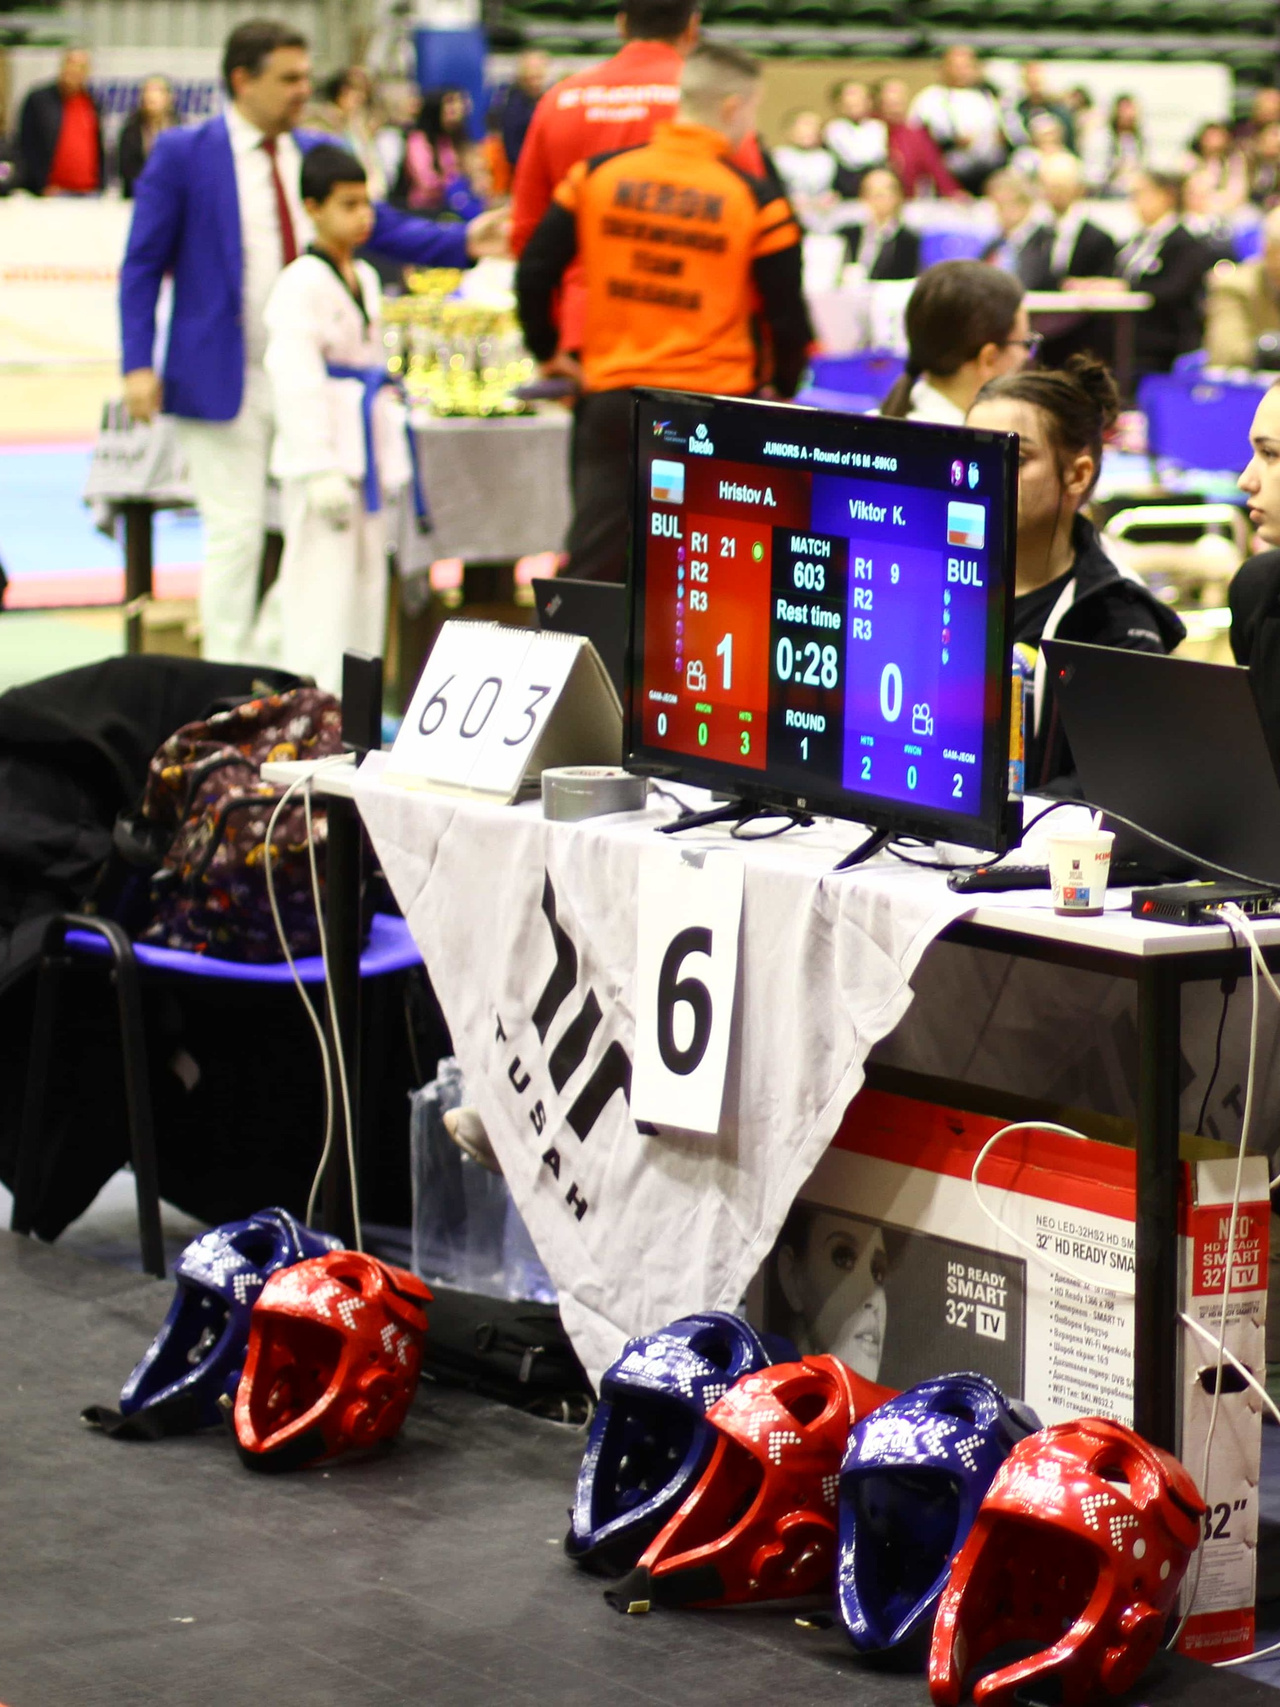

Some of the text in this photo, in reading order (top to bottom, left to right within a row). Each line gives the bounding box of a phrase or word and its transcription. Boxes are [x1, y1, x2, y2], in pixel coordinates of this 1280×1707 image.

[688, 436, 714, 456] Daedo
[763, 441, 799, 459] JUNIORS
[800, 446, 807, 460] A
[813, 448, 840, 464] Round
[841, 452, 850, 465] of
[862, 455, 871, 468] M
[719, 480, 777, 507] Hristov A.
[849, 499, 906, 526] Viktor K.
[651, 512, 683, 539] BUL
[691, 531, 736, 558] R1 21
[791, 535, 831, 557] MATCH
[690, 560, 709, 583] R2
[793, 561, 825, 591] 603
[854, 557, 900, 584] R1 9
[947, 558, 983, 587] BUL
[690, 590, 708, 612] R3
[853, 587, 873, 610] R2
[776, 599, 841, 629] Rest time
[853, 618, 872, 641] R3
[716, 633, 733, 690] 1
[776, 637, 838, 689] 0:28
[880, 662, 903, 722] 0
[657, 712, 667, 736] 0
[786, 709, 826, 733] ROUND
[698, 722, 708, 746] 0
[740, 731, 750, 755] 3
[800, 736, 808, 760] 1
[943, 748, 976, 764] GAM-JEOM
[861, 756, 871, 781] 2
[907, 765, 917, 790] 0
[952, 773, 963, 798] 2
[656, 926, 713, 1076] 6
[1036, 1214, 1135, 1250] NEO LED-32HS2 HD SM
[1036, 1232, 1052, 1250] 32"
[1055, 1237, 1070, 1256] HD
[1073, 1242, 1107, 1265] READY
[1203, 1249, 1260, 1266] SMART
[1204, 1243, 1220, 1252] HD
[947, 1261, 1006, 1288] HD READY
[1236, 1268, 1255, 1283] TV
[946, 1275, 1008, 1307] SMART
[1054, 1286, 1064, 1297] HD
[946, 1298, 1000, 1333] 32" TV
[1093, 1310, 1116, 1325] SMART
[1116, 1317, 1125, 1328] TV
[1112, 1374, 1125, 1386] DVB
